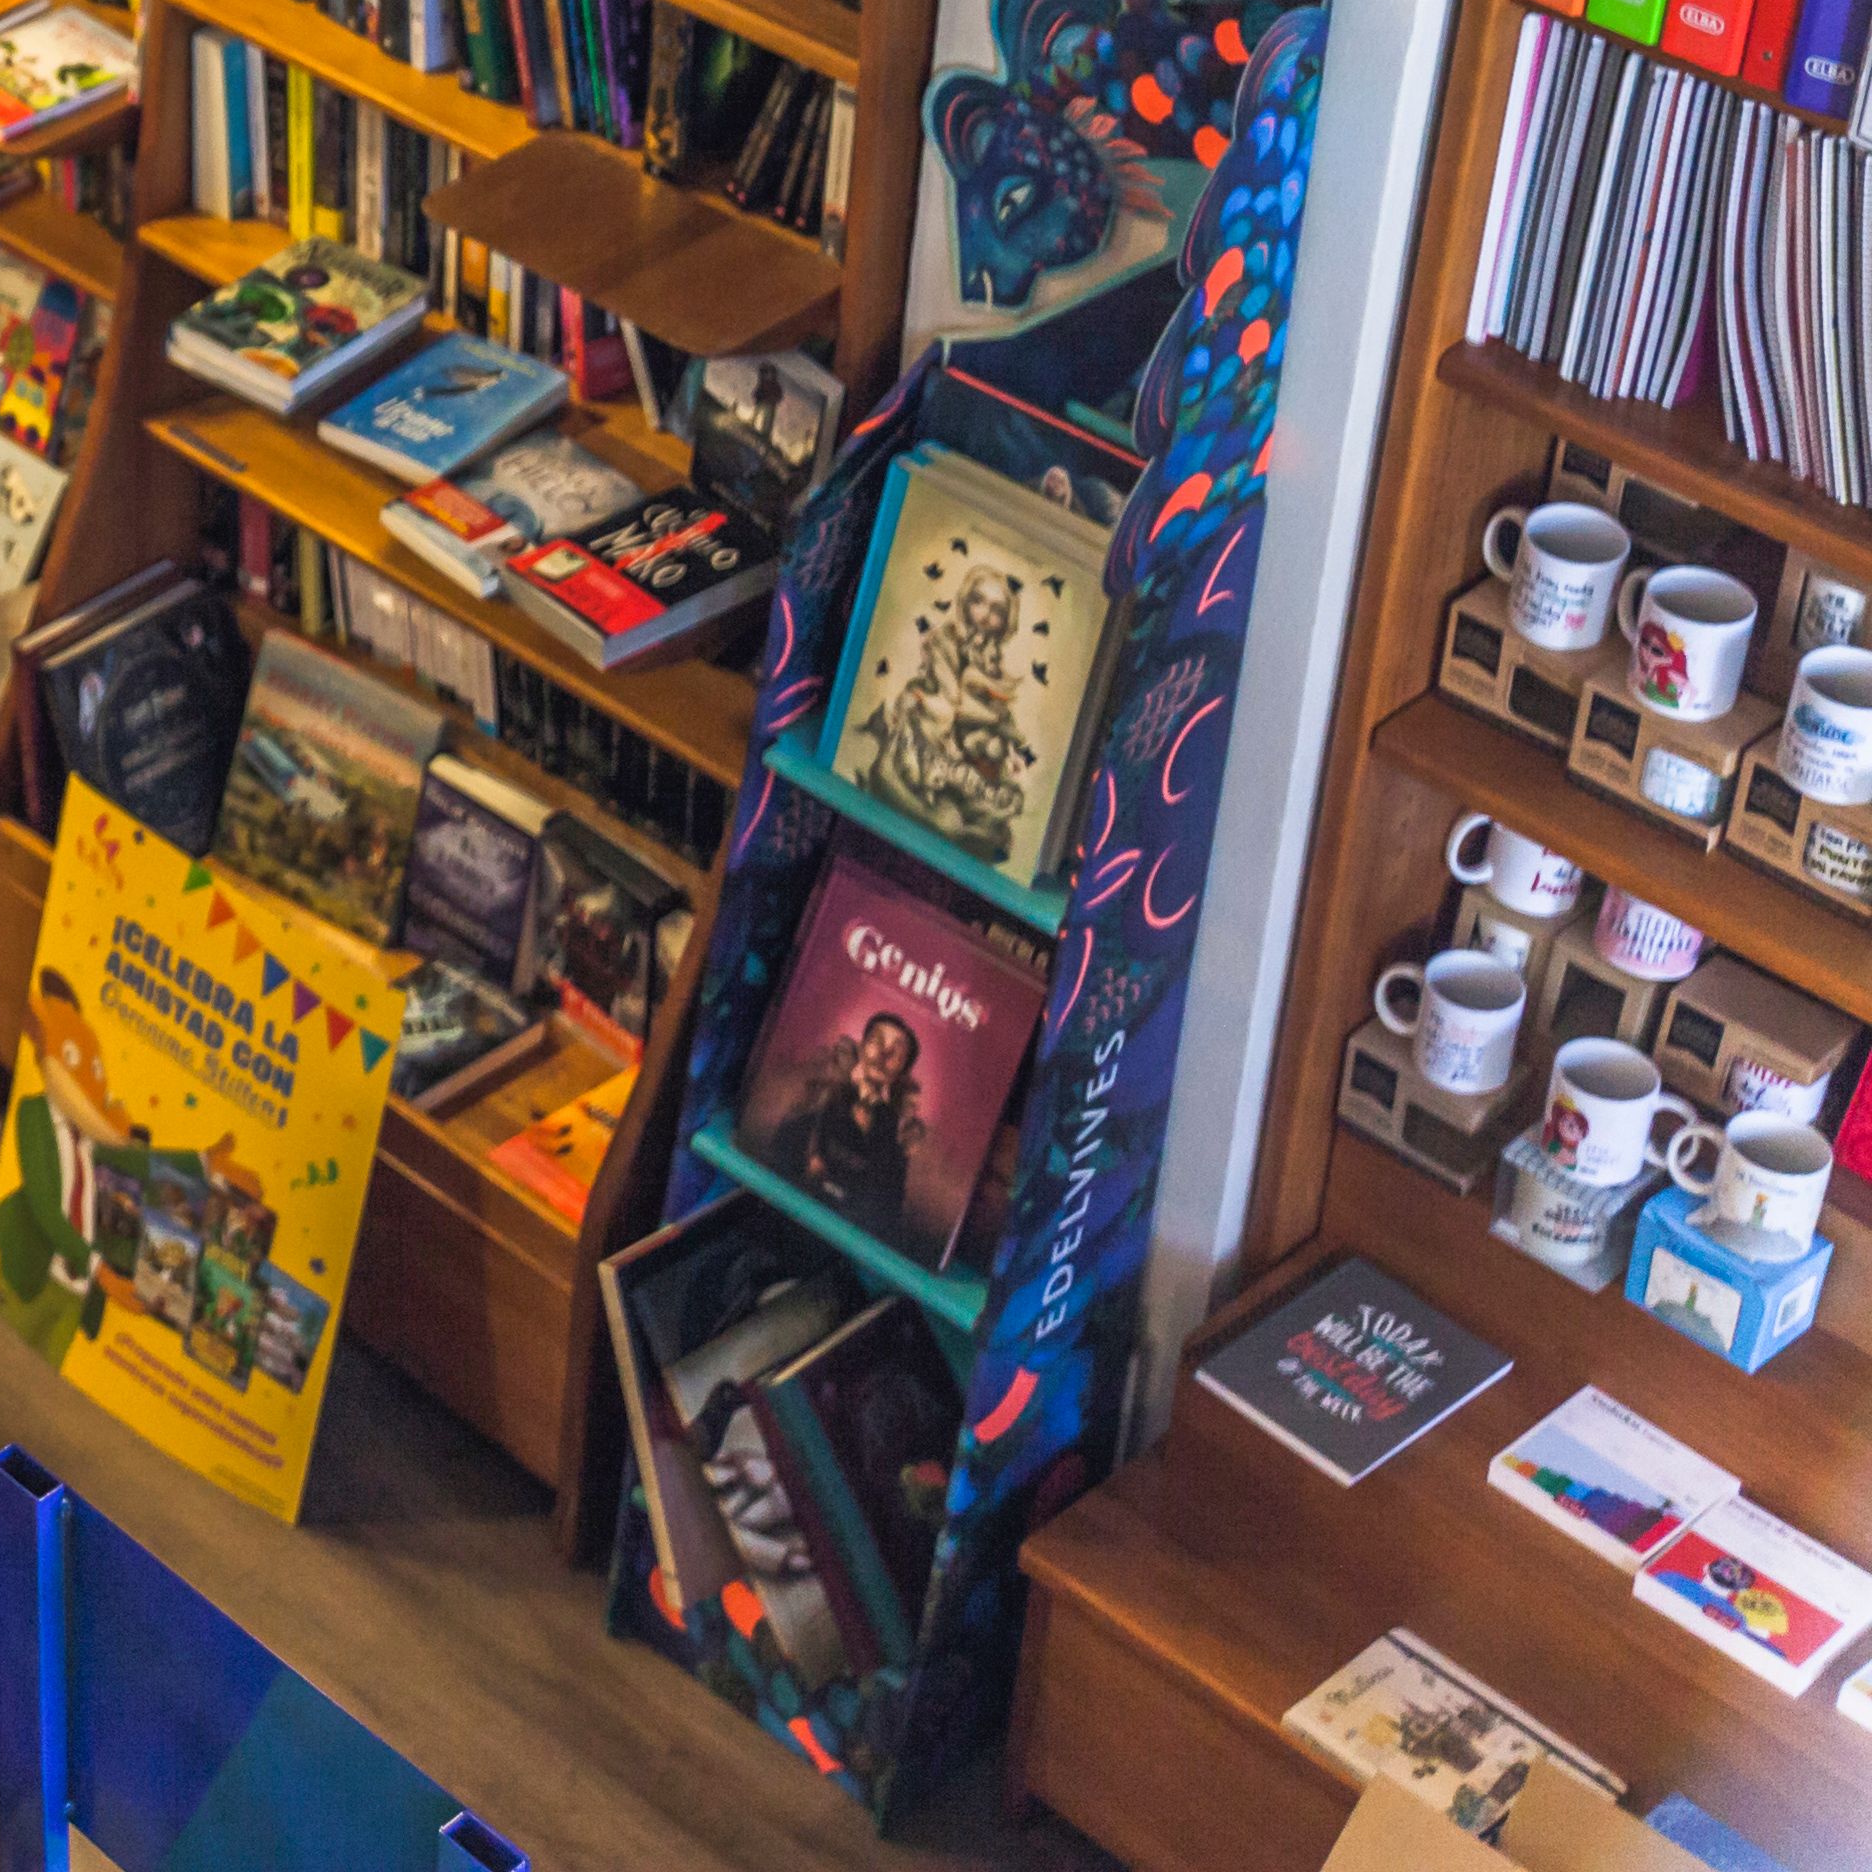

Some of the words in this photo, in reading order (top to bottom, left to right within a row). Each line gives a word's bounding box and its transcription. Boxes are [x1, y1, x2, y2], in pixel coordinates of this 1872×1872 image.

[1687, 7, 1720, 33] ELBA
[1811, 60, 1850, 83] ELBA
[105, 951, 225, 1050] AMISTAD
[232, 1040, 295, 1098] CON
[113, 915, 254, 1036] ¡CELEBRA
[262, 1020, 299, 1065] LA
[1035, 1029, 1126, 1342] EDELVIVES
[1314, 1313, 1364, 1355] WILL
[1386, 1363, 1434, 1402] THE
[1358, 1304, 1444, 1367] TODAY
